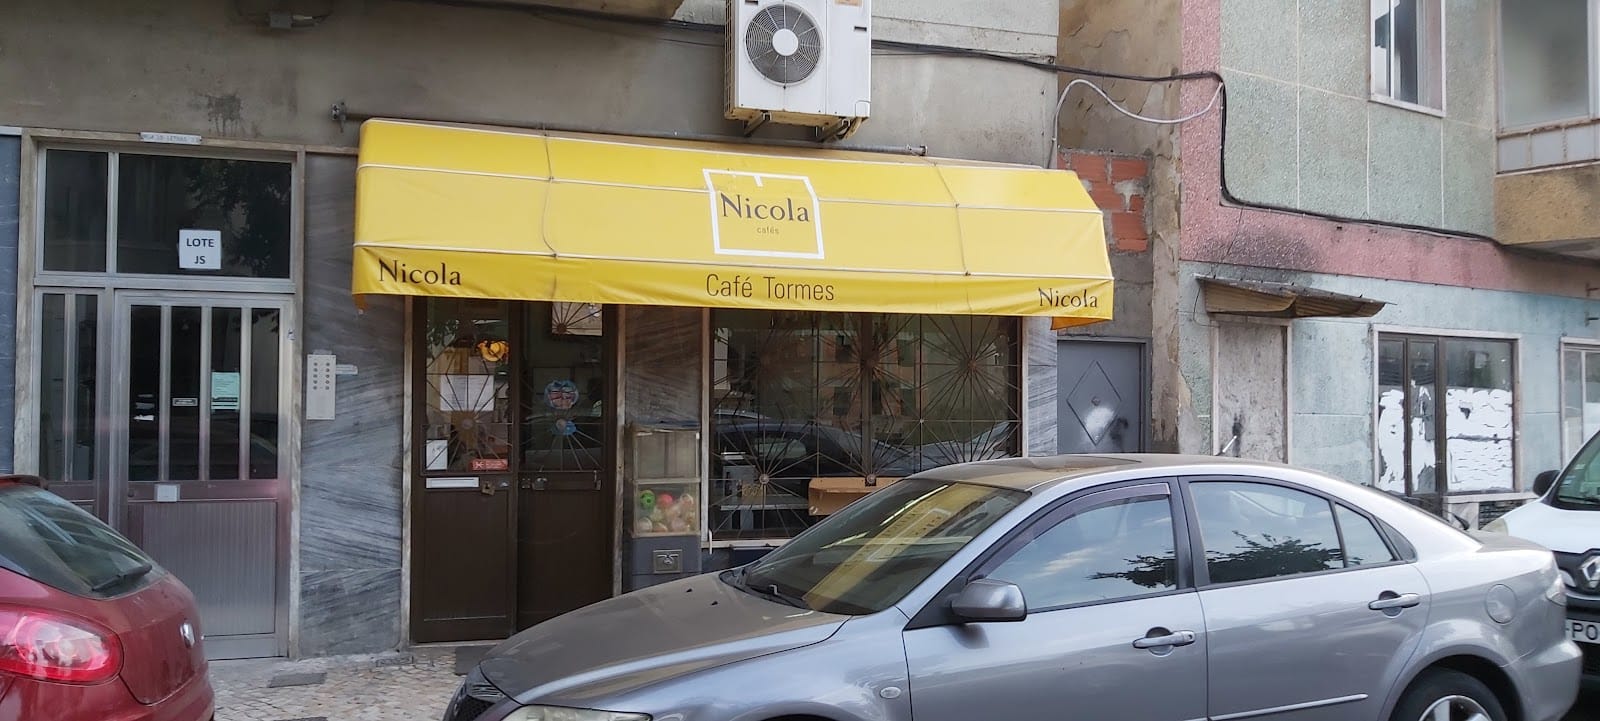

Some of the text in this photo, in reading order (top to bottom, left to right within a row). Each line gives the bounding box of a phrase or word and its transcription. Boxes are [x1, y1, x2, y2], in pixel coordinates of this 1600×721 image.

[720, 192, 810, 223] Nicola
[756, 226, 780, 235] cafés
[186, 238, 215, 248] LOTE
[194, 255, 206, 265] JS
[378, 258, 462, 286] Nicola
[706, 274, 835, 302] Café Tormes
[1038, 287, 1099, 308] Nicola
